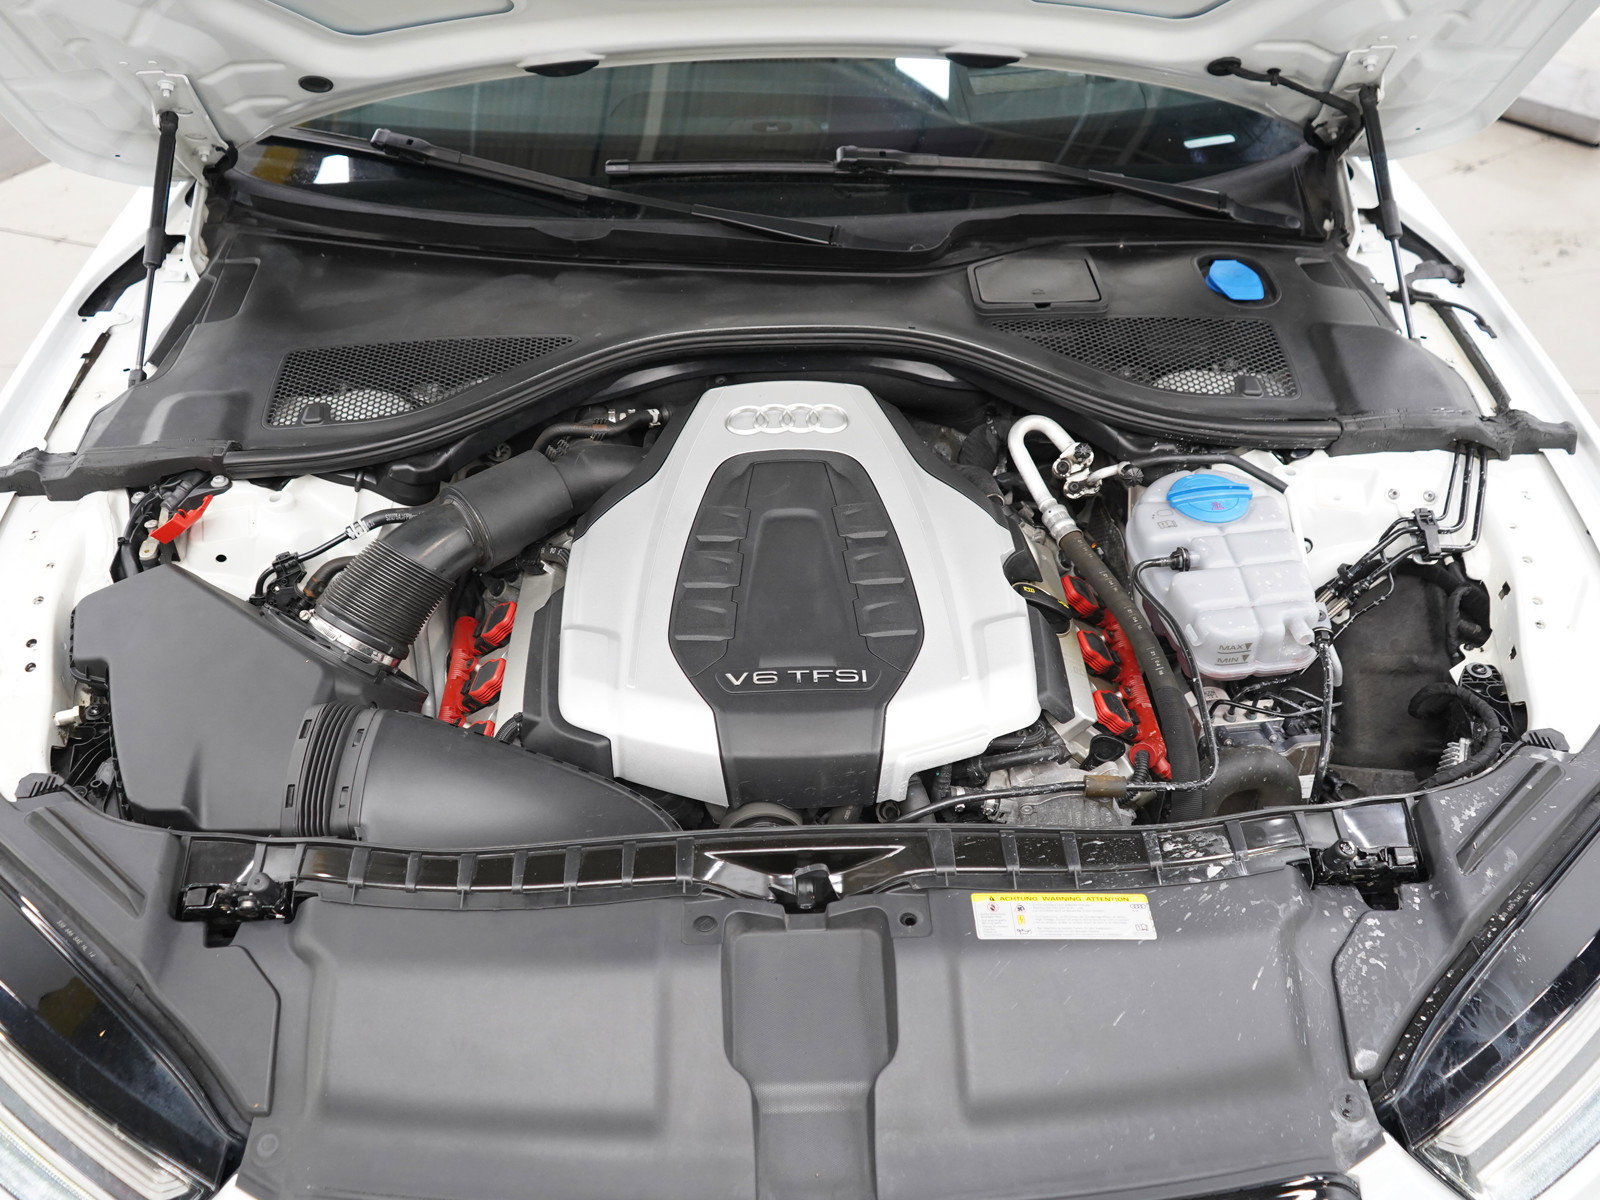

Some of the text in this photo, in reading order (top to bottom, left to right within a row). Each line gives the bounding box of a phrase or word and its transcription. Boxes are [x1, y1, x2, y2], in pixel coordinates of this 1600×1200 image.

[1218, 643, 1245, 652] MAX
[1217, 655, 1240, 663] MIN
[725, 669, 867, 686] V6 TFSI
